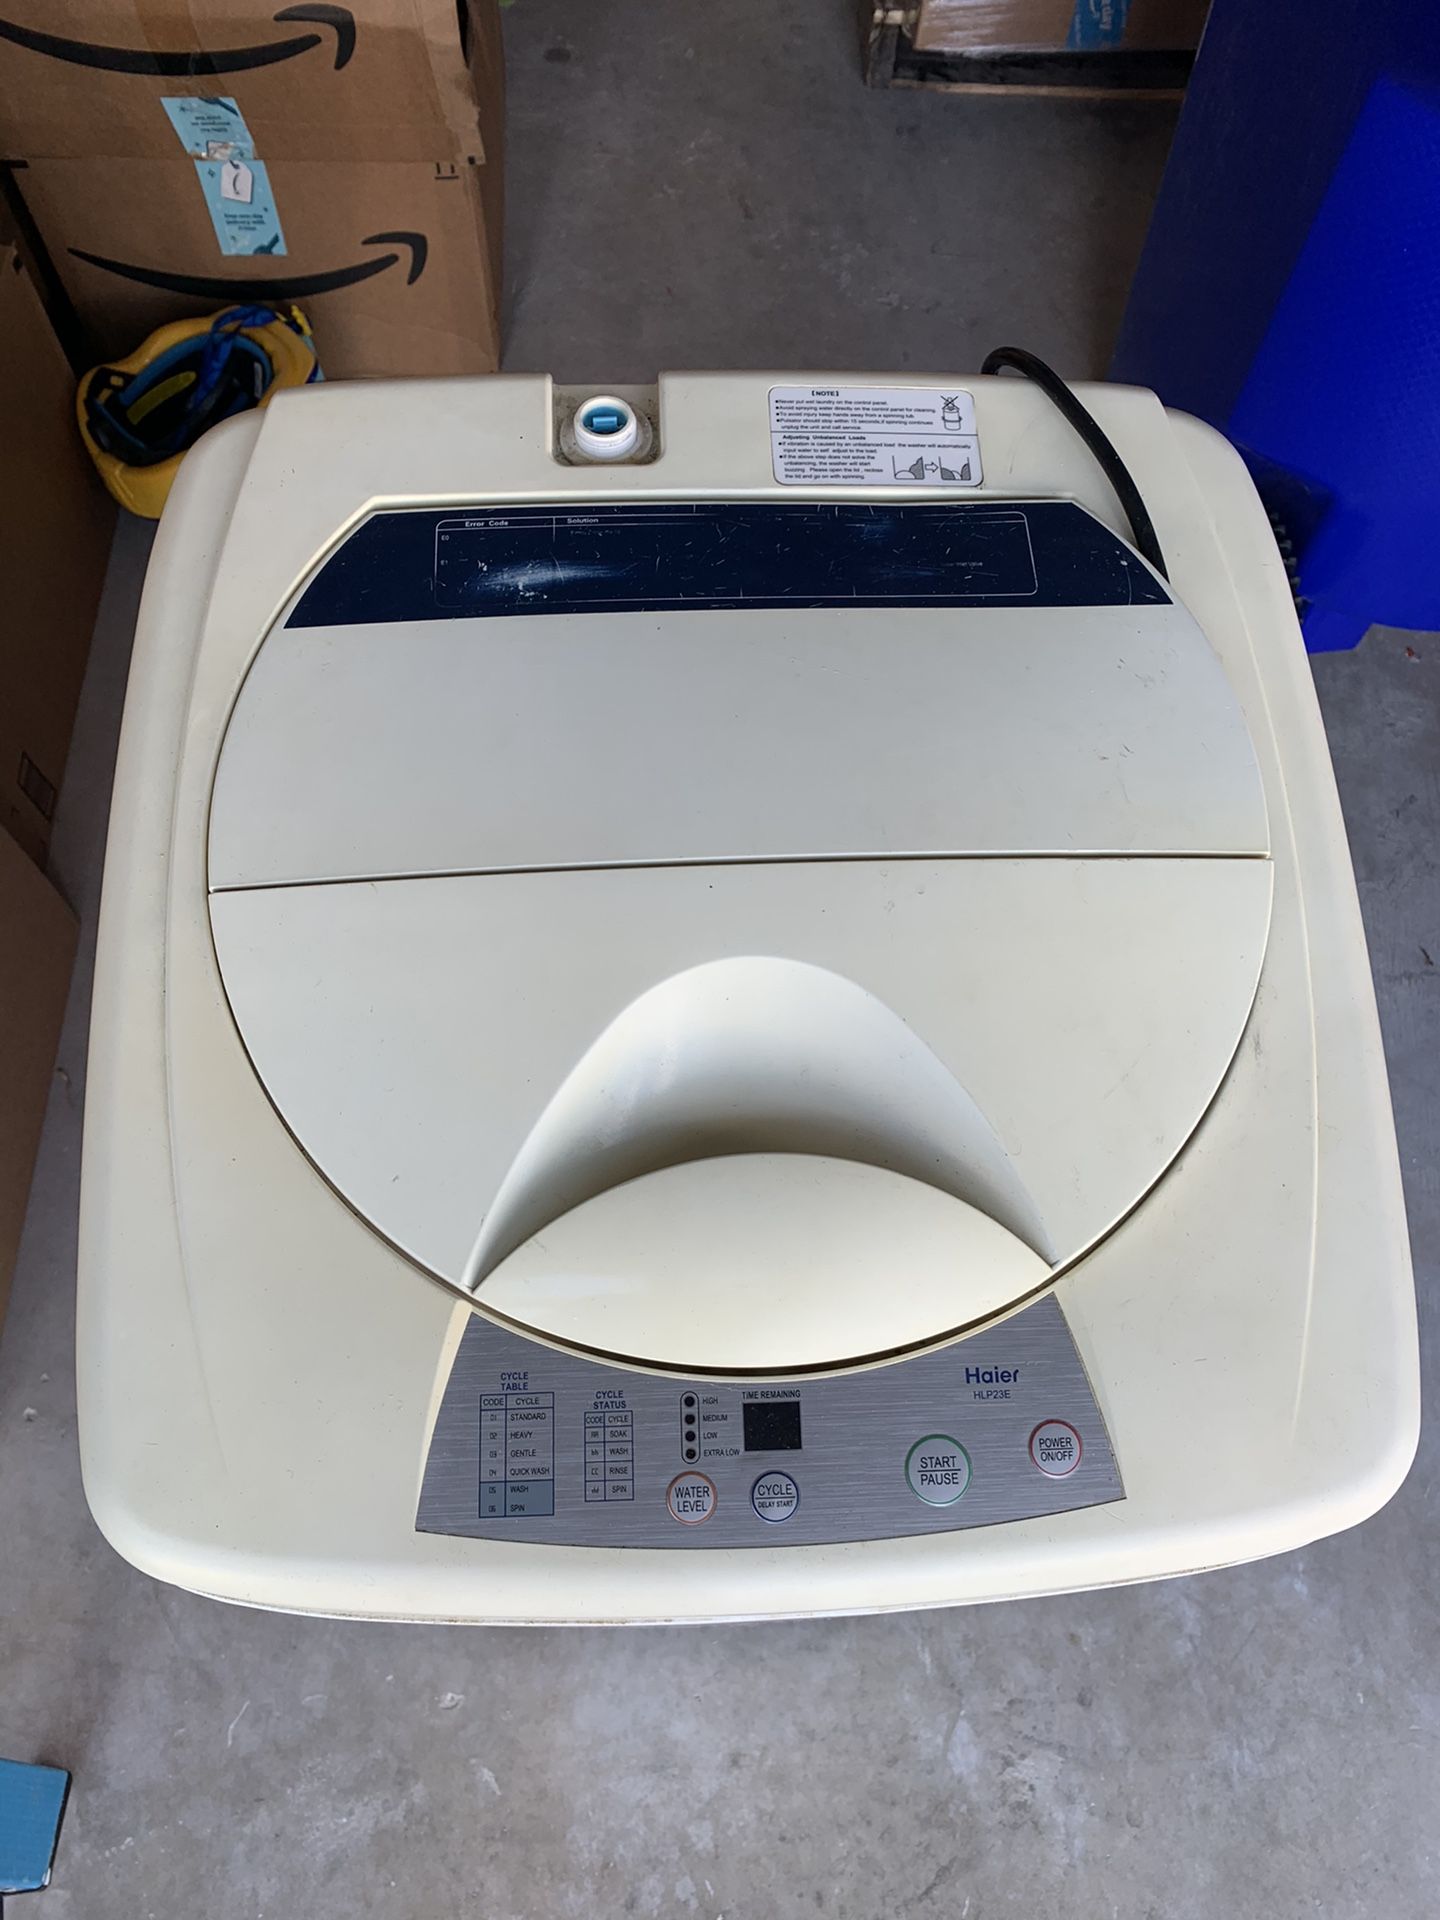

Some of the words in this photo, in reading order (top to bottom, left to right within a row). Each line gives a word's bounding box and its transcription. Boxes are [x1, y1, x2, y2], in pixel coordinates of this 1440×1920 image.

[500, 1371, 529, 1380] CYCLE
[965, 1366, 1019, 1384] Haier
[501, 1382, 529, 1391] TABLE
[595, 1390, 624, 1399] CYCLE
[742, 1391, 759, 1400] TIME
[760, 1389, 801, 1400] REMAINING
[973, 1390, 1011, 1400] HLP23E
[483, 1398, 504, 1406] CODE
[515, 1397, 540, 1406] CYCLE
[593, 1400, 627, 1410] STATUS
[702, 1396, 719, 1405] HIGH
[510, 1412, 547, 1422] STANDARD
[586, 1415, 604, 1425] CODE
[608, 1414, 629, 1424] CYCLE
[702, 1414, 728, 1422] MEDIUM
[510, 1431, 533, 1439] HEAVY
[609, 1430, 628, 1438] SOAK
[703, 1431, 718, 1440] LOW
[1038, 1437, 1073, 1448] POWER
[510, 1449, 537, 1458] GENTLE
[609, 1447, 629, 1456] WASH
[725, 1449, 741, 1457] LOW
[1040, 1450, 1074, 1462] ON/OFF
[920, 1456, 957, 1469] START
[509, 1468, 530, 1477] QUICK
[530, 1467, 550, 1475] WASH
[609, 1465, 629, 1475] RINSE
[920, 1472, 959, 1486] PAUSE
[510, 1484, 529, 1493] WASH
[611, 1484, 627, 1493] SPIN
[674, 1485, 710, 1499] WATER
[757, 1483, 793, 1496] CYCLE
[510, 1504, 525, 1512] SPIN
[676, 1500, 708, 1513] LEVEL
